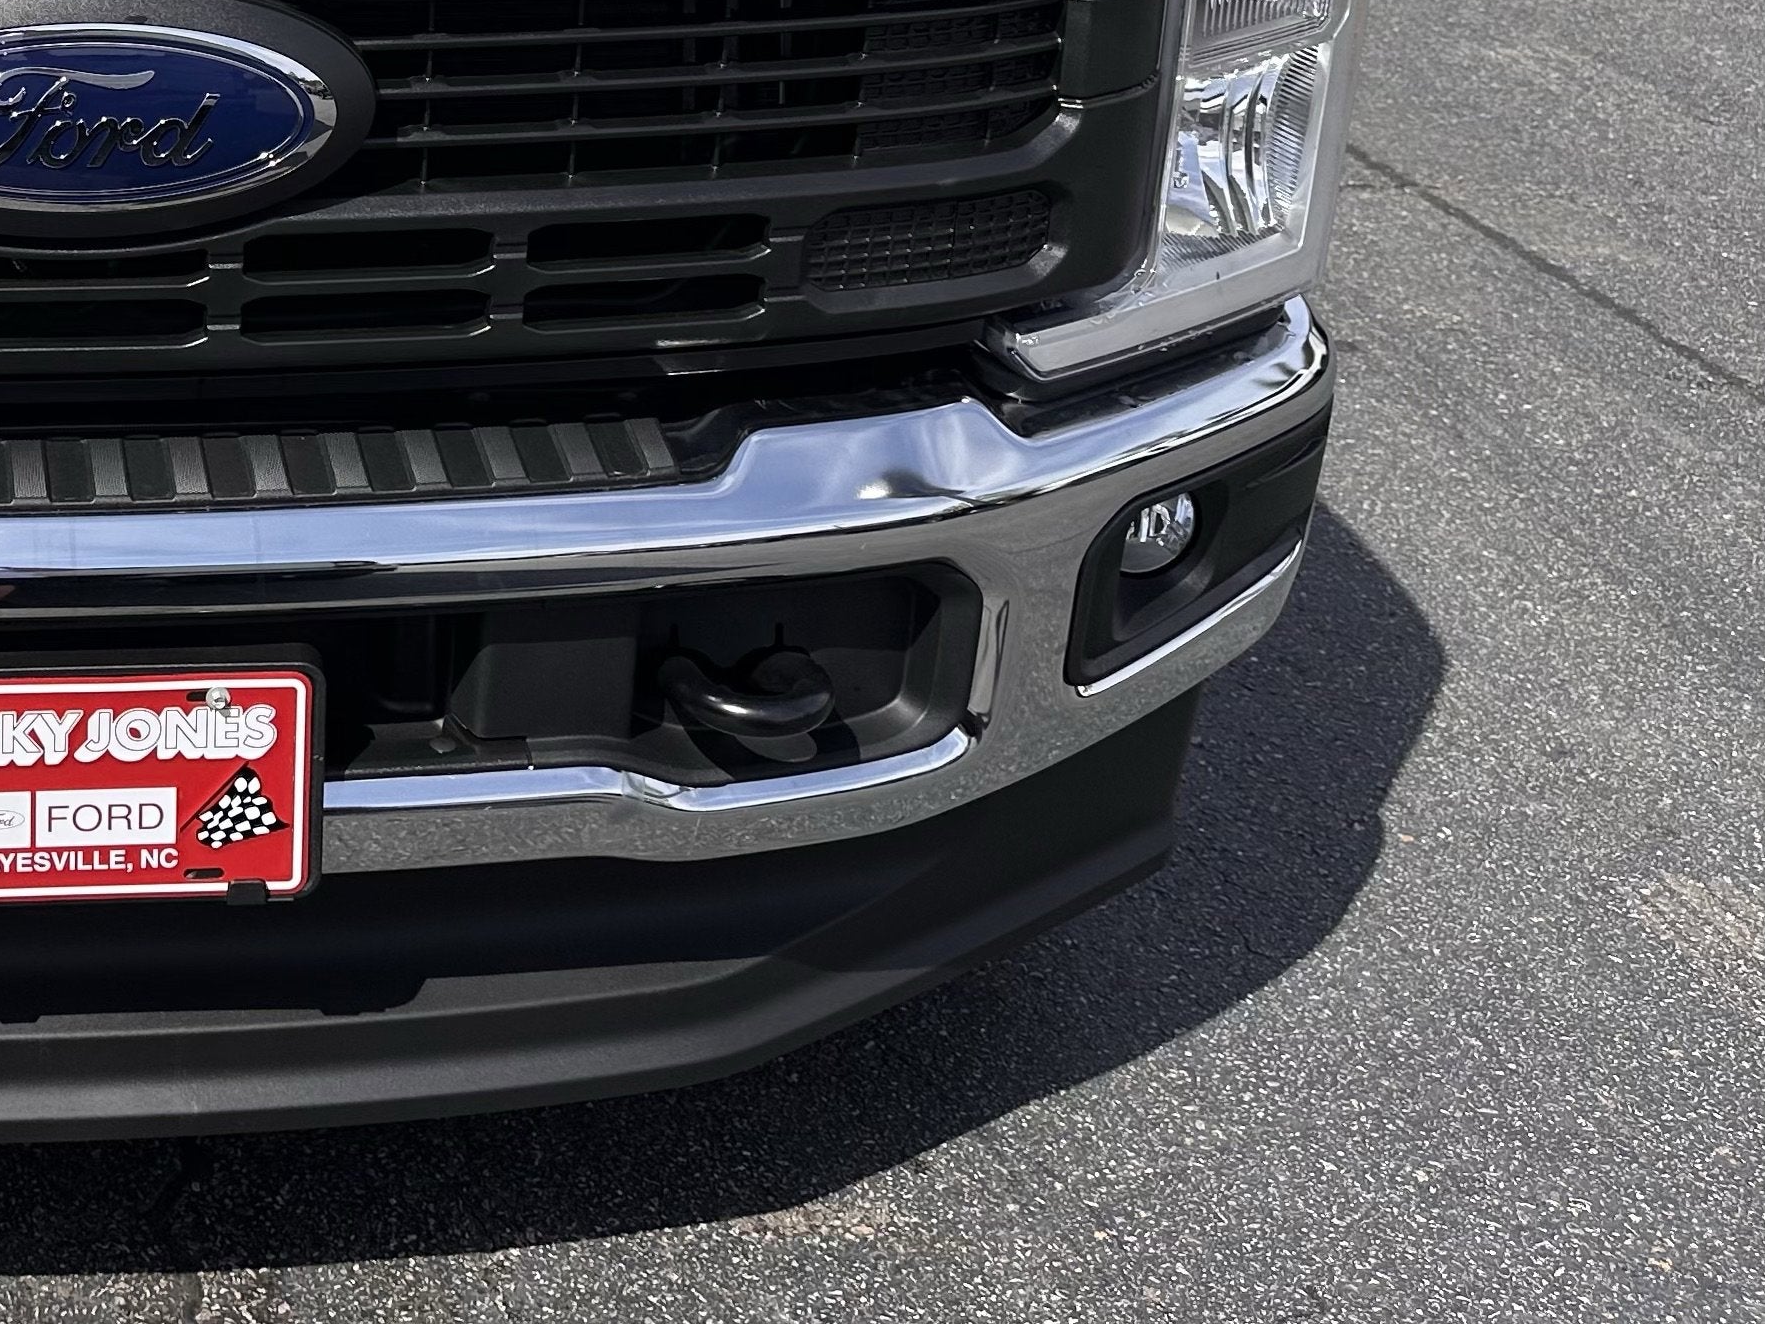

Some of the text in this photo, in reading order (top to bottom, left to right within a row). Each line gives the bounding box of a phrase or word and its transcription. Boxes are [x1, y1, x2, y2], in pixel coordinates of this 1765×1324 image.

[74, 703, 278, 763] JONES
[47, 802, 165, 834] FORD
[139, 847, 179, 870] NC
